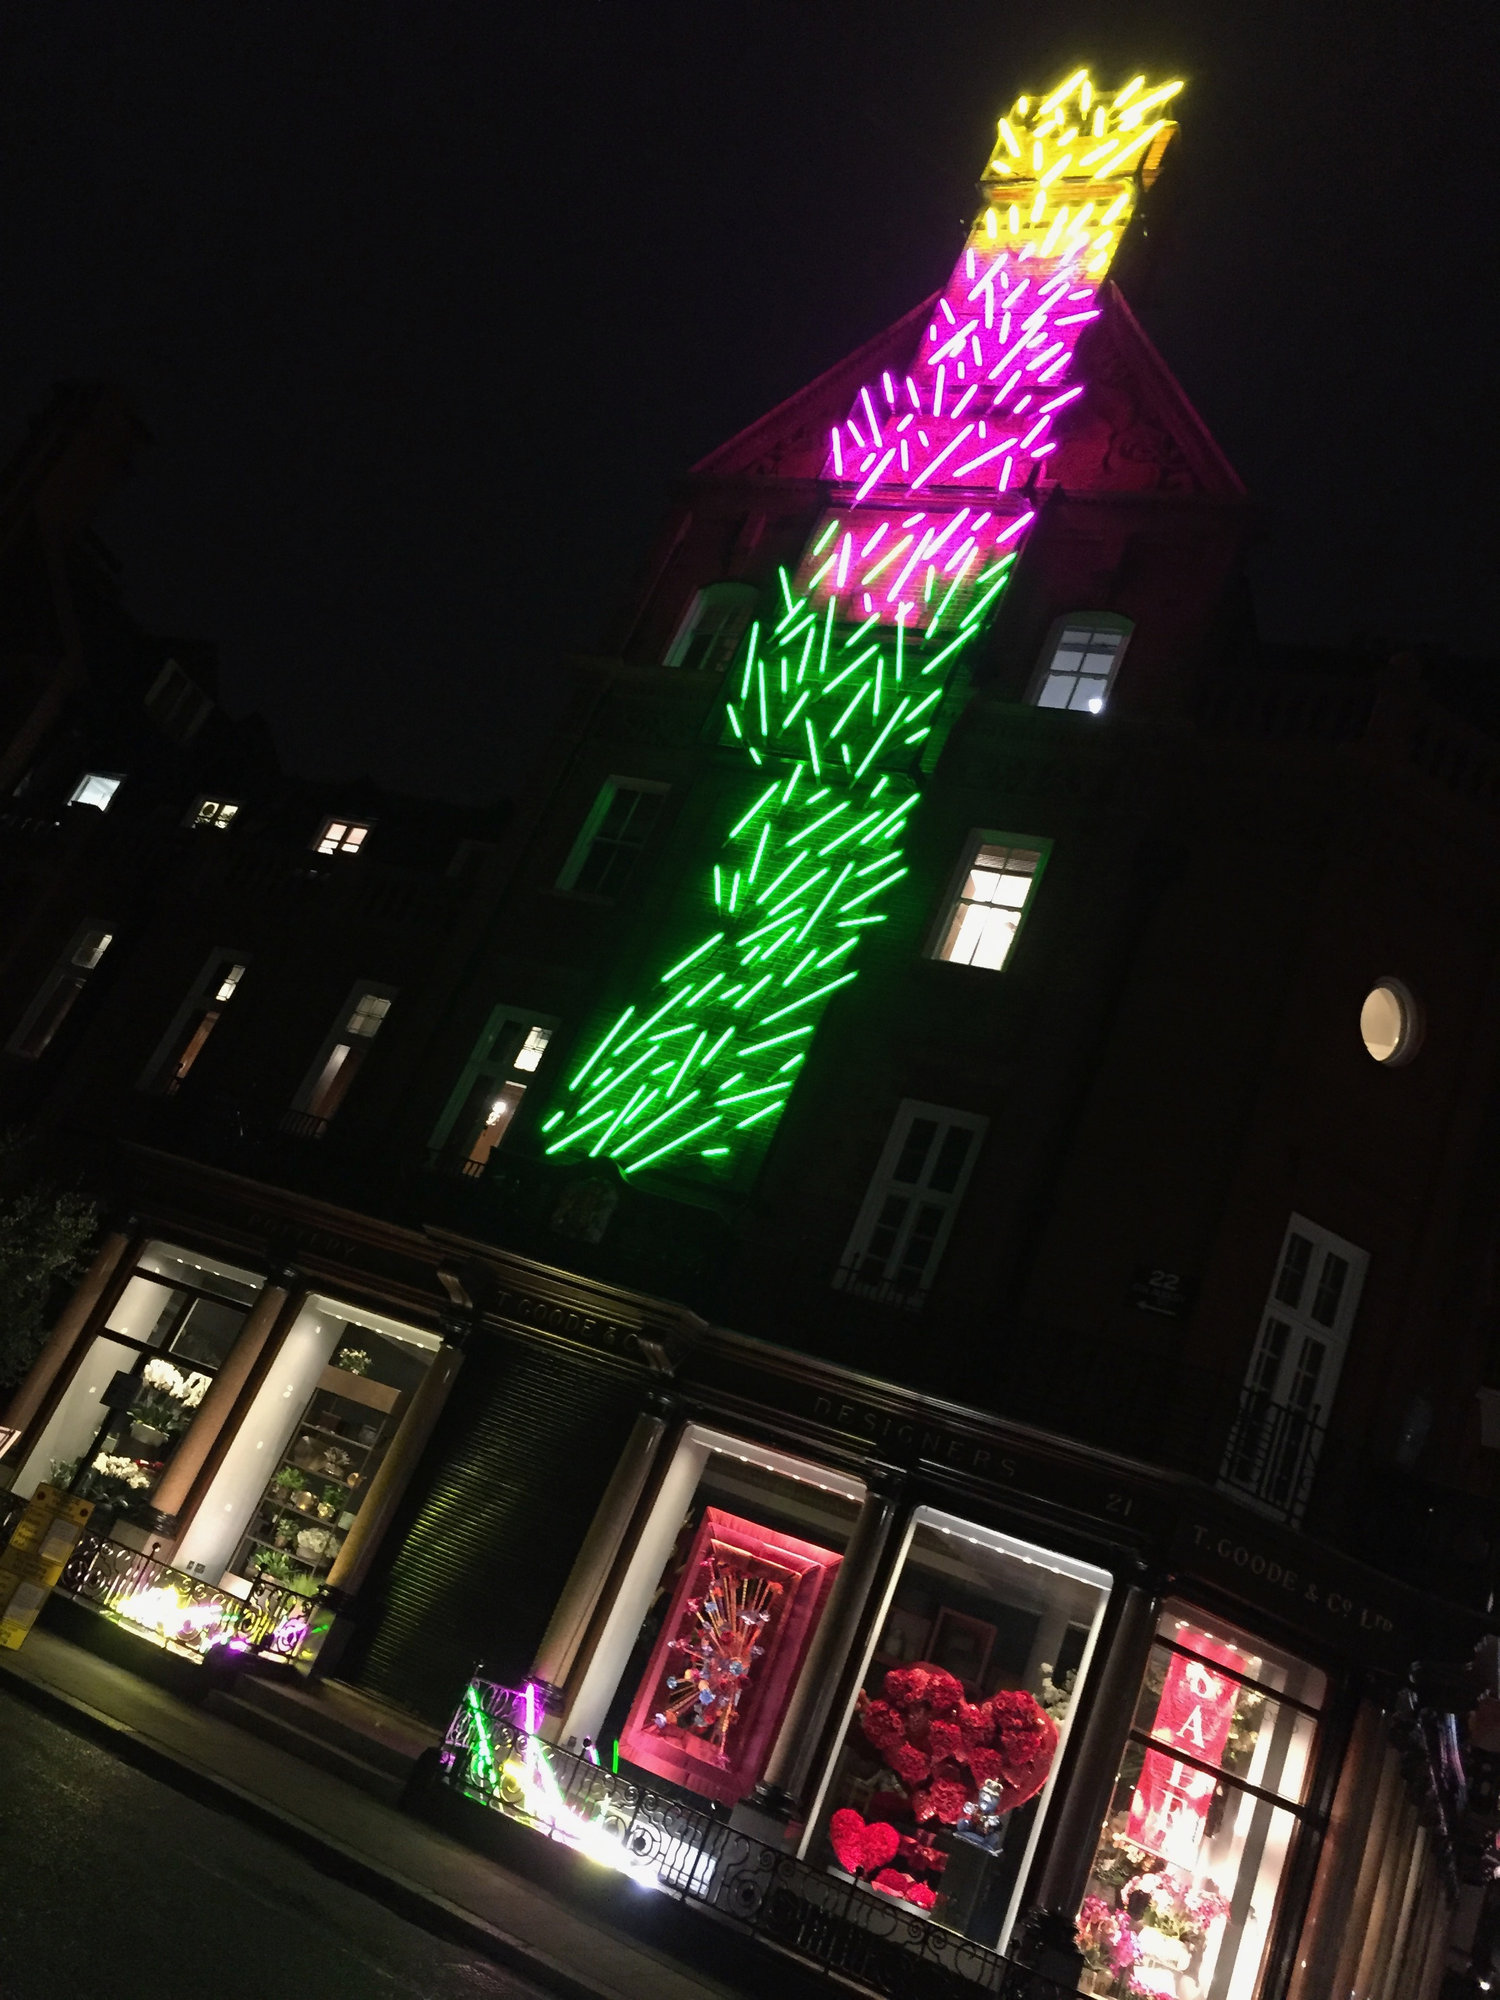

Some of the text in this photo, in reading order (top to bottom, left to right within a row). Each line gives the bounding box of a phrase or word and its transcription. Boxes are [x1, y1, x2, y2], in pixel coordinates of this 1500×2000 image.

[1148, 1270, 1180, 1291] 22
[518, 1298, 597, 1337] GOODE
[814, 1397, 1016, 1477] DESIGNERS
[1104, 1493, 1133, 1517] 21
[1193, 1524, 1211, 1550] T.
[1217, 1538, 1298, 1592] GOODE
[1304, 1583, 1320, 1602] &
